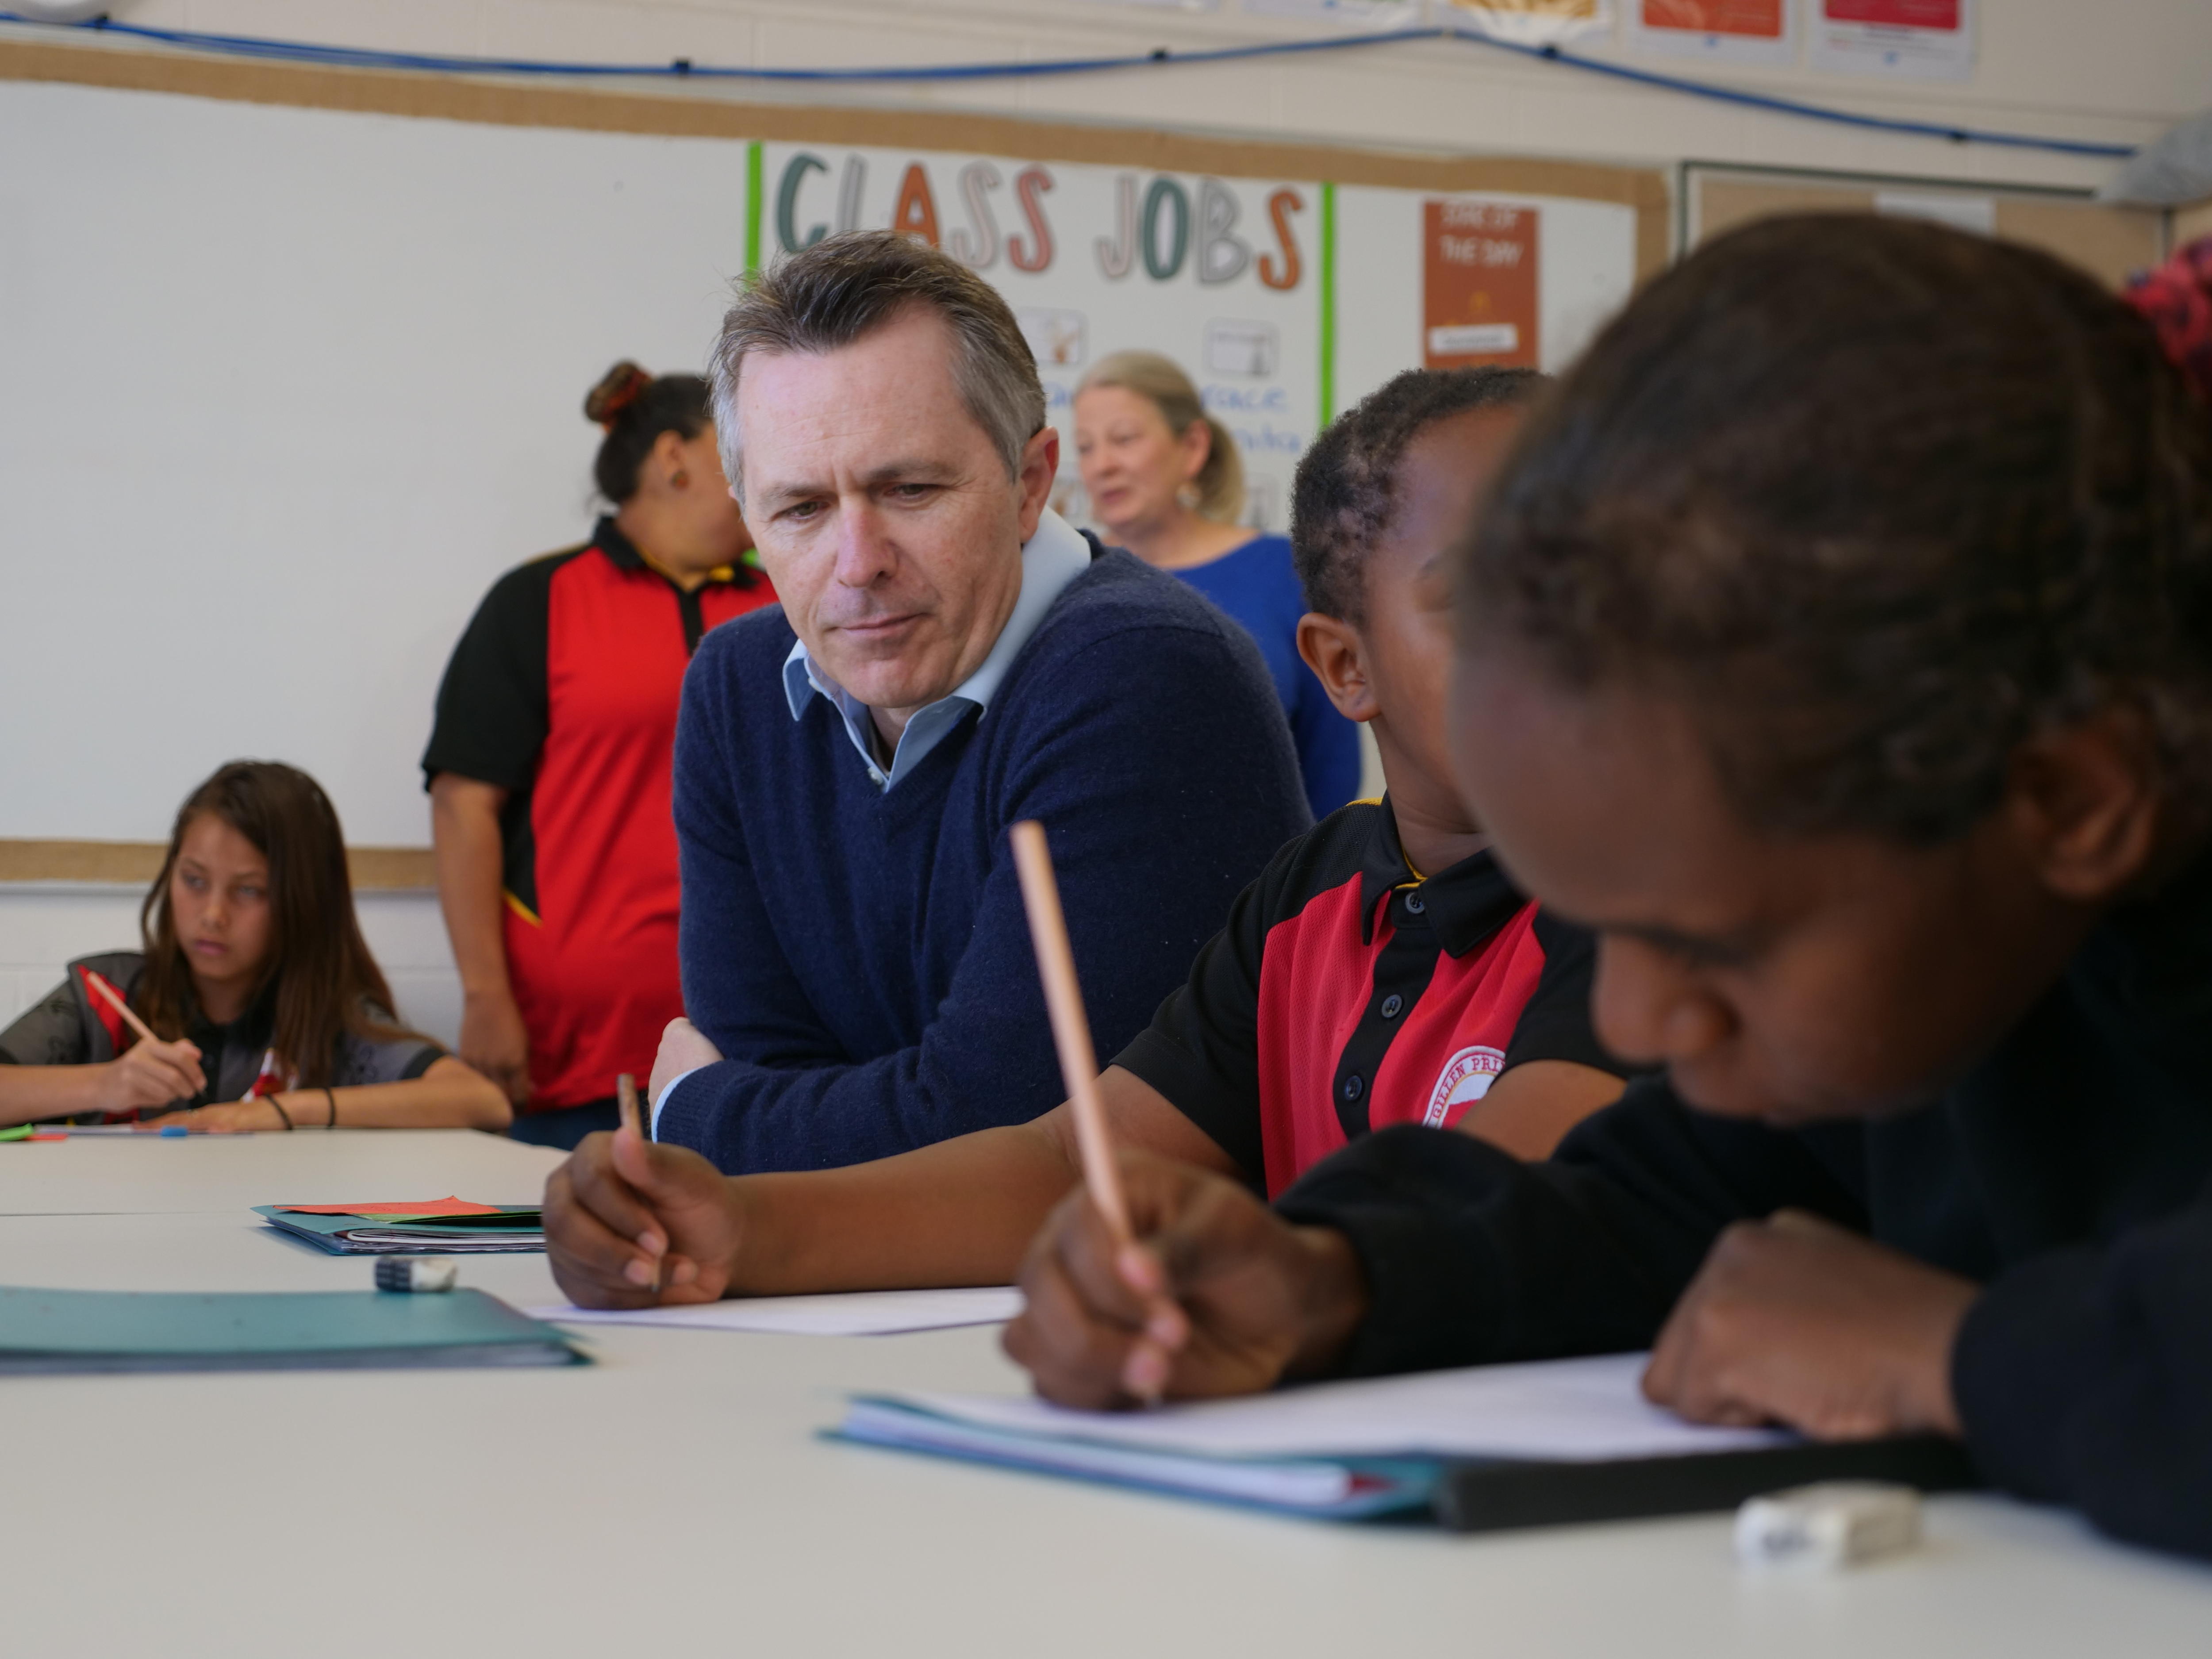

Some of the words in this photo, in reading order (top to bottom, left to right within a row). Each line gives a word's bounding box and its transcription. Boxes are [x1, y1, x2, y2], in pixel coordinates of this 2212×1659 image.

[1096, 175, 1303, 291] JOBS
[1439, 235, 1478, 266] THE
[1433, 1063, 1466, 1118] GILLEN
[1471, 1057, 1505, 1072] PRI
